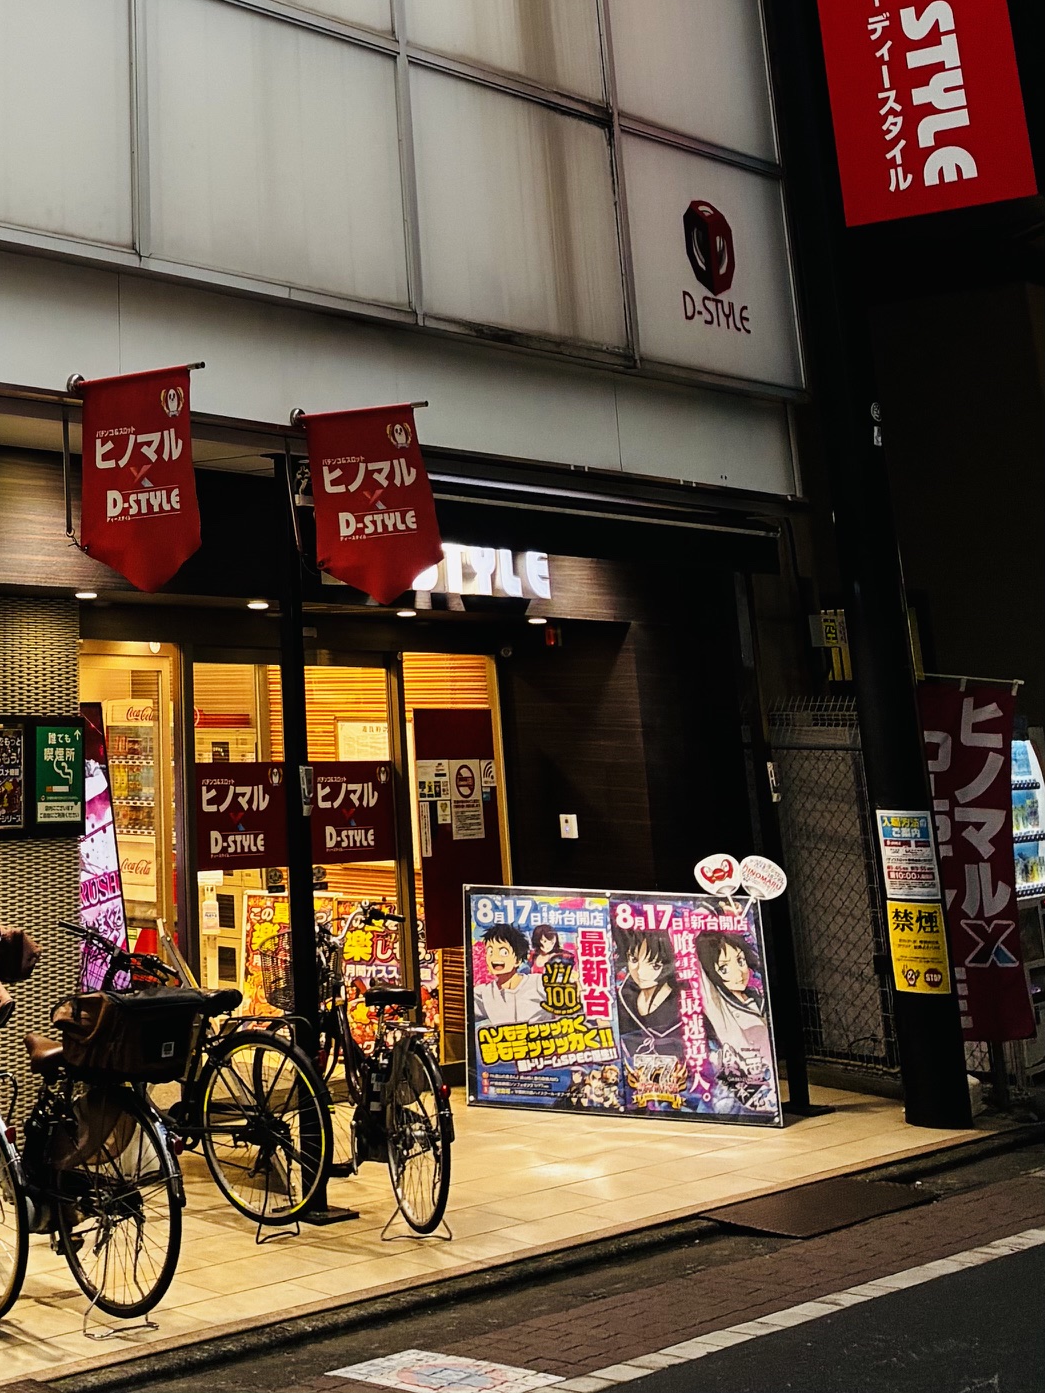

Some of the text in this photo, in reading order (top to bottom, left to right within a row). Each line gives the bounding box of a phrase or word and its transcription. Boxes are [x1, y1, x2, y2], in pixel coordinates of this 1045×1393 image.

[867, 12, 913, 192] ディースタイル
[682, 290, 751, 334] D-STYLE
[96, 428, 183, 469] ヒノマル
[322, 458, 417, 494] ヒノマル
[106, 488, 181, 518] D-STYLE
[338, 510, 417, 537] D-STYLE
[202, 784, 270, 813] ヒノマル
[317, 781, 379, 809] ヒノマル
[954, 696, 1011, 918] ヒノマル
[210, 830, 265, 854] D-STYLE
[325, 825, 375, 848] D-STYLE
[892, 908, 939, 934] 禁煙
[578, 929, 612, 1019] 最新台
[925, 973, 942, 982] STOP
[545, 987, 577, 1007] 100
